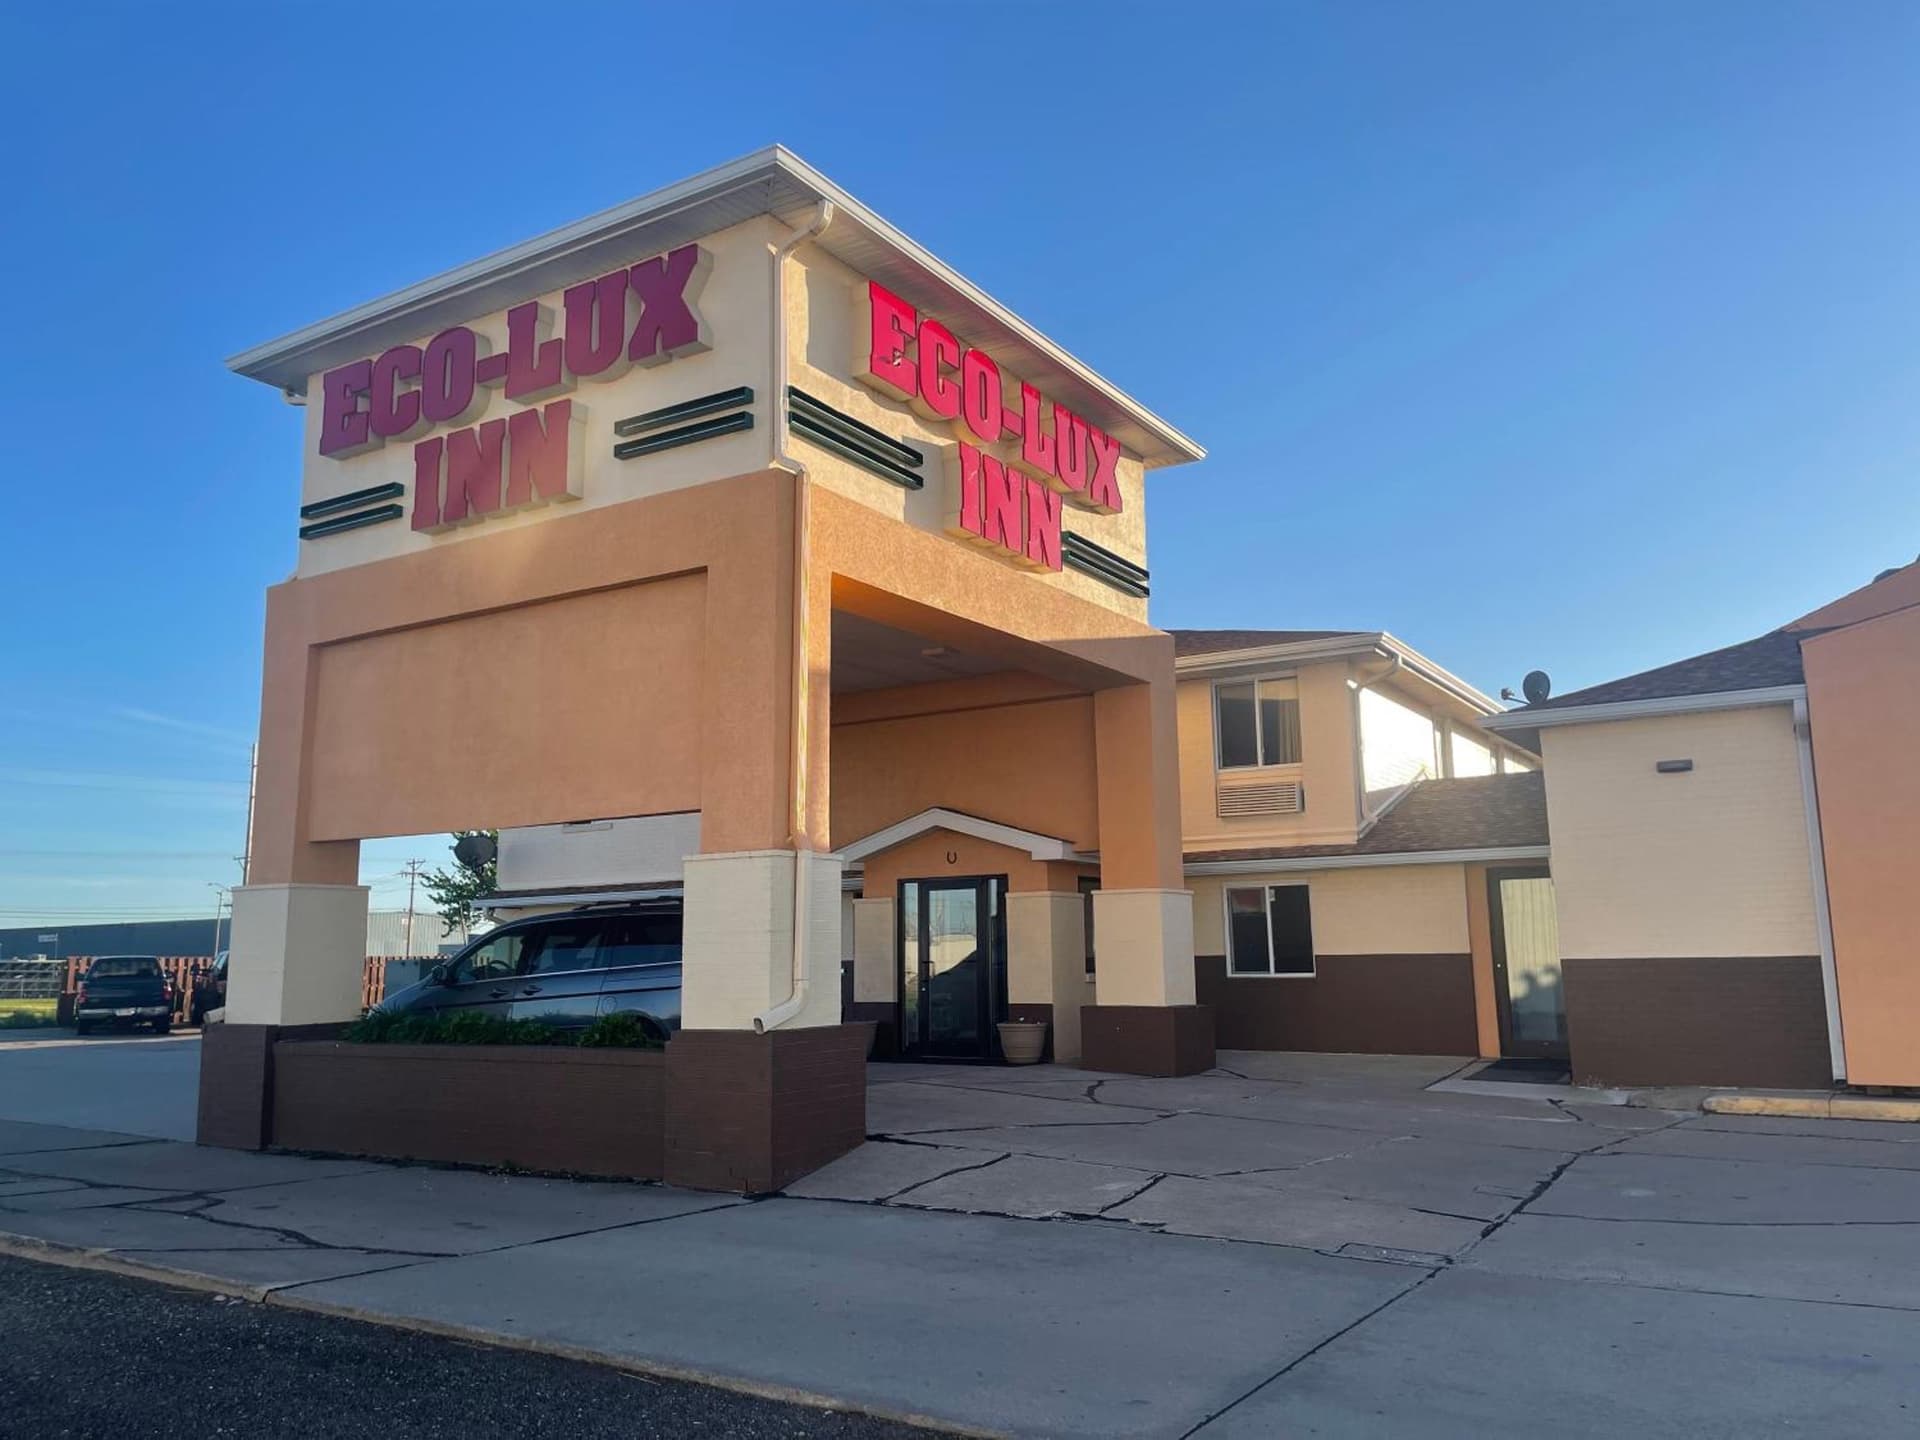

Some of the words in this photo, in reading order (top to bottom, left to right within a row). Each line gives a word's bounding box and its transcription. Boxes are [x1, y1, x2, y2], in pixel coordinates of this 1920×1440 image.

[319, 243, 700, 456] ECO-LUX
[869, 280, 1123, 513] ECO-LUX
[411, 399, 572, 532] INN
[959, 440, 1063, 572] INN
